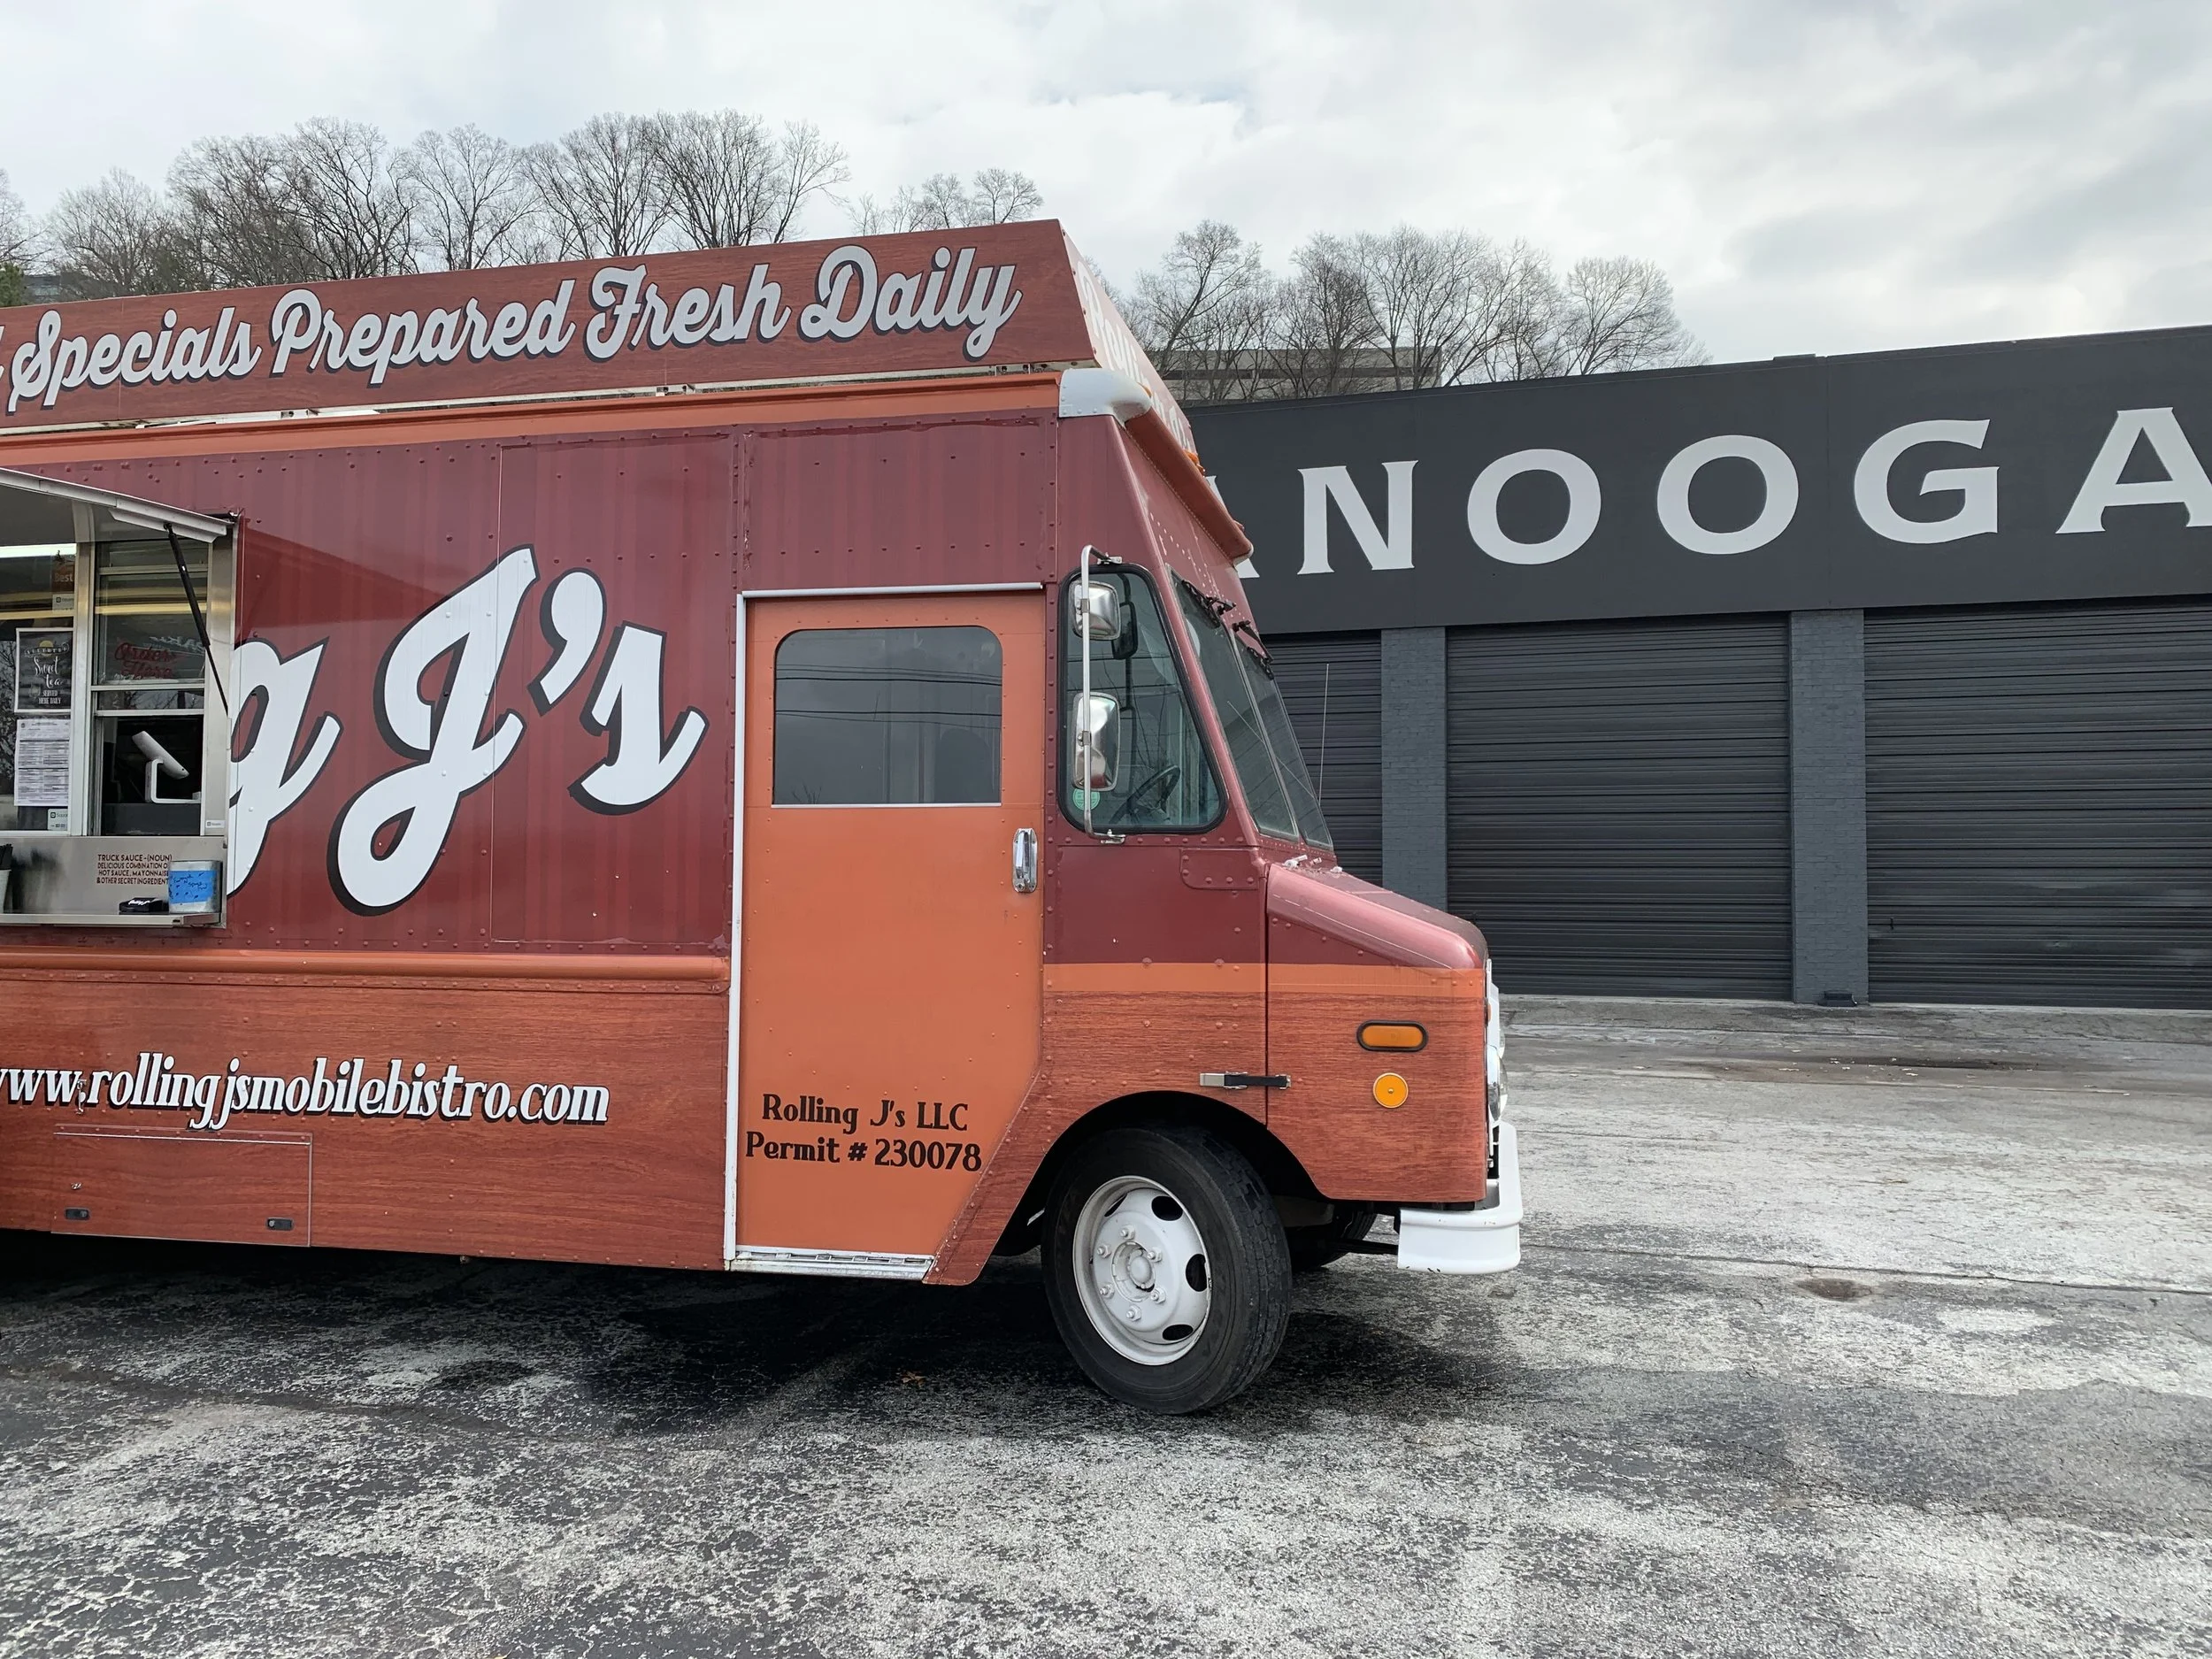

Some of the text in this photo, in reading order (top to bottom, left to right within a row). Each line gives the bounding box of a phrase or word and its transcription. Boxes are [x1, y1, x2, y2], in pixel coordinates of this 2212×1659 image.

[7, 307, 263, 413] Specials
[272, 280, 576, 385] Prepared
[585, 264, 792, 358] Fresh
[800, 245, 1023, 358] Daily
[1204, 406, 2212, 579] NOOGA
[337, 547, 707, 908] J's
[0, 1051, 610, 1131] ww.rollingjsmobilebistro.com
[745, 1130, 983, 1172] Permit # 230078
[762, 1094, 969, 1135] Rolling J's LLC
